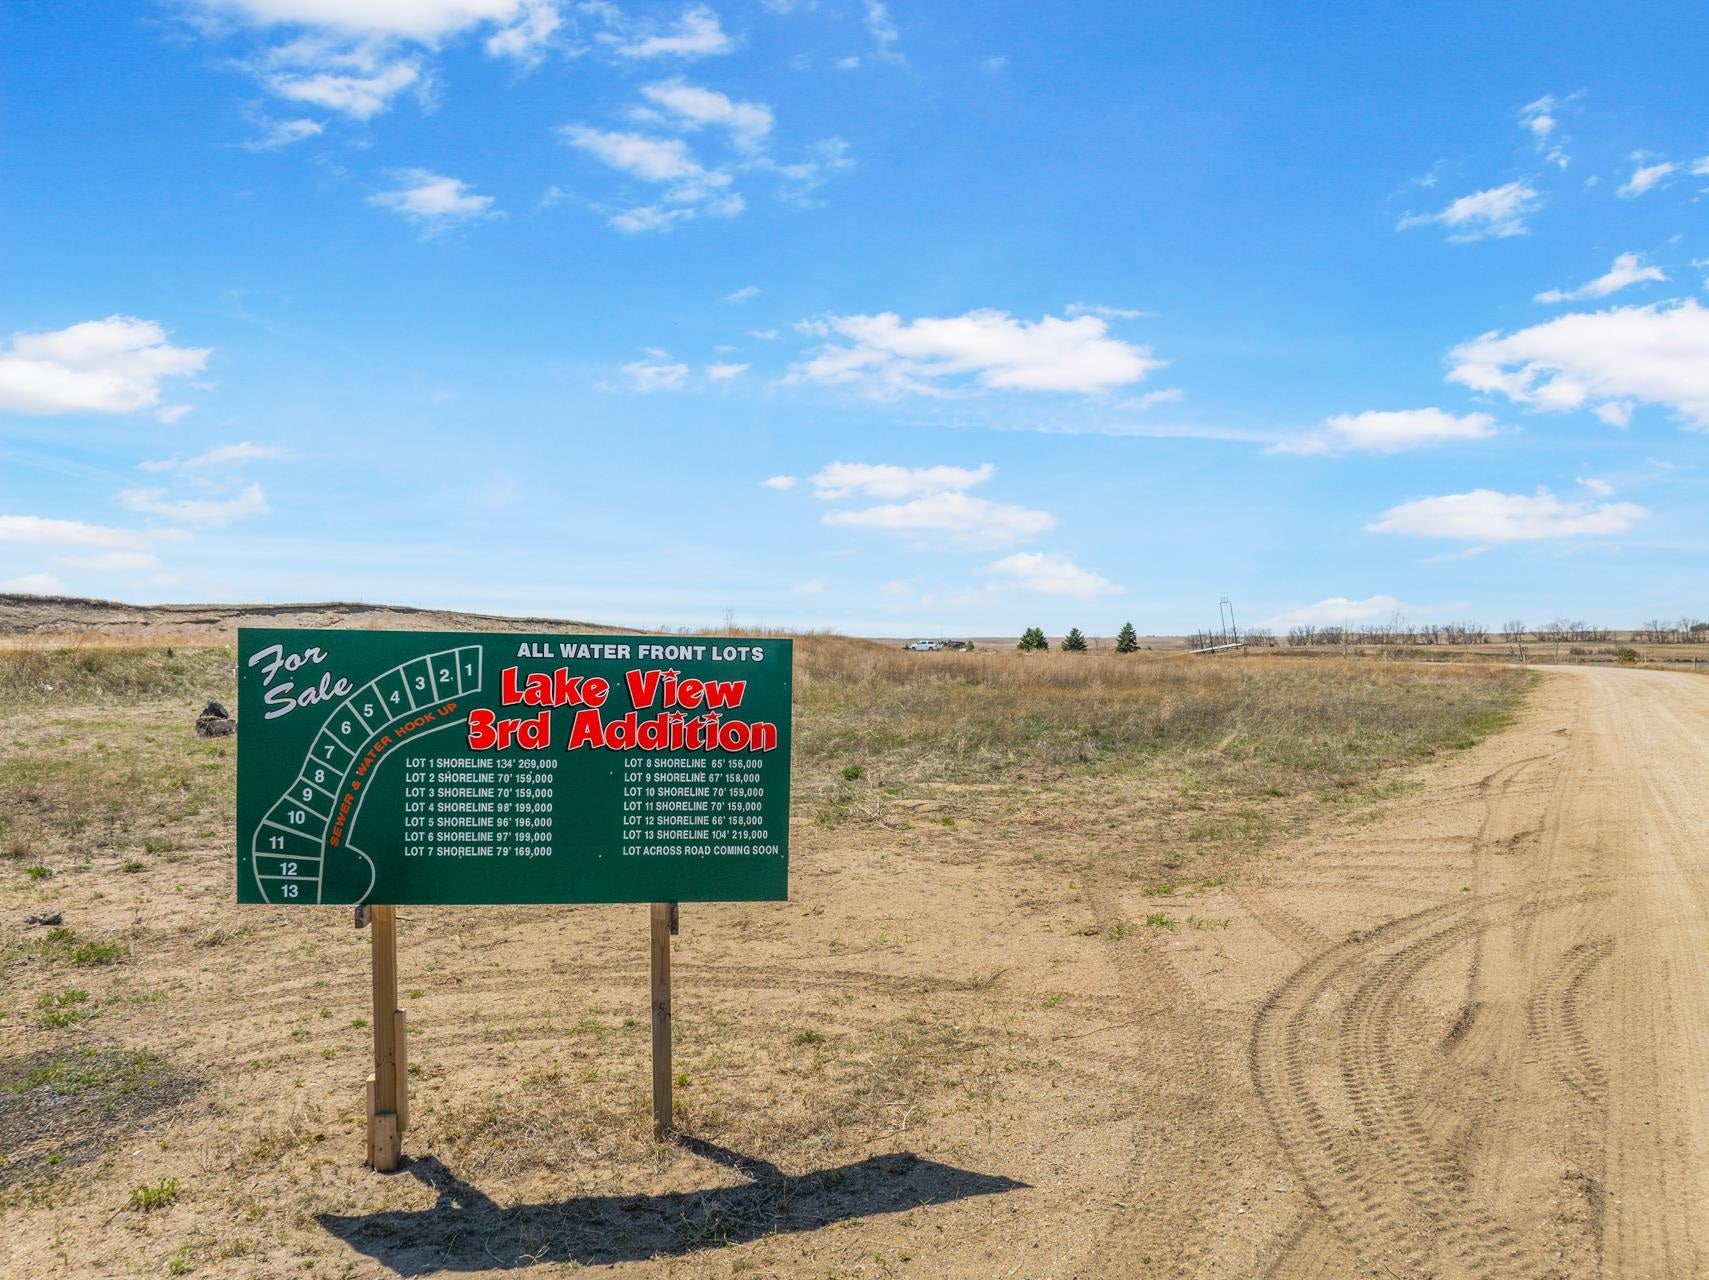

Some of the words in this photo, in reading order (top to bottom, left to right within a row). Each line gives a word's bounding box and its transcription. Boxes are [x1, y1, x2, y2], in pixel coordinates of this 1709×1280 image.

[516, 643, 555, 658] ALL
[559, 643, 631, 660] WATER
[638, 644, 706, 660] FRONT
[711, 645, 764, 662] LOTS
[248, 644, 328, 686] For
[465, 664, 472, 676] 1
[439, 669, 450, 682] 2
[415, 677, 426, 690] 3
[501, 665, 610, 708] Lake
[625, 667, 747, 710] View
[263, 672, 353, 720] Sale
[390, 691, 400, 704] 4
[364, 704, 374, 717] 5
[437, 702, 457, 716] UP
[341, 721, 351, 734] 6
[394, 712, 437, 737] HOOK
[467, 708, 552, 750] 3rd
[567, 708, 778, 752] Addition
[324, 746, 335, 759] 7
[356, 735, 393, 776] WATER
[406, 759, 427, 768] LOT
[429, 759, 434, 768] 1
[436, 759, 494, 768] SHORELINE
[496, 759, 516, 768] 134'
[518, 759, 558, 769] 269,000
[624, 759, 643, 768] LOT
[646, 759, 652, 768] 8
[654, 759, 707, 768] SHORELINE
[711, 760, 726, 769] 65'
[728, 760, 763, 769] 156,000
[314, 769, 325, 783] 8
[405, 773, 426, 782] LOT
[429, 774, 435, 783] 2
[437, 773, 495, 782] SHORELINE
[497, 774, 513, 783] 70'
[515, 773, 553, 784] 159,000
[624, 773, 643, 782] LOT
[645, 773, 652, 782] 9
[653, 773, 706, 782] SHORELINE
[708, 774, 723, 783] 67'
[725, 774, 760, 783] 158,000
[351, 781, 362, 790] &
[624, 787, 643, 796] LOT
[645, 788, 655, 797] 10
[657, 787, 710, 796] SHORELINE
[712, 788, 727, 797] 70'
[729, 788, 764, 797] 159,000
[302, 788, 313, 801] 9
[405, 788, 426, 797] LOT
[428, 788, 435, 797] 3
[437, 788, 495, 797] SHORELINE
[497, 789, 513, 798] 70'
[515, 789, 553, 798] 159,000
[405, 803, 426, 812] LOT
[428, 803, 435, 812] 4
[437, 803, 494, 812] SHORELINE
[497, 803, 512, 812] 98'
[514, 803, 553, 813] 199,000
[623, 802, 643, 811] LOT
[645, 802, 654, 811] 11
[655, 802, 708, 811] SHORELINE
[710, 802, 725, 811] 70'
[727, 802, 762, 812] 159,000
[287, 811, 306, 824] 10
[330, 793, 354, 848] SEWER
[405, 817, 425, 826] LOT
[428, 818, 434, 827] 5
[437, 817, 494, 826] SHORELINE
[496, 818, 512, 827] 96'
[514, 818, 553, 828] 196,000
[623, 816, 642, 825] LOT
[644, 816, 655, 825] 12
[656, 816, 710, 825] SHORELINE
[711, 816, 726, 825] 66'
[728, 816, 763, 826] 158,000
[404, 832, 425, 841] LOT
[427, 833, 434, 842] 6
[436, 832, 494, 841] SHORELINE
[496, 832, 512, 841] 97'
[514, 833, 552, 842] 199,000
[623, 830, 642, 839] LOT
[644, 831, 654, 840] 13
[656, 830, 709, 839] SHORELINE
[711, 831, 730, 840] 104'
[732, 830, 768, 840] 219,000
[269, 836, 285, 849] 11
[404, 847, 425, 856] LOT
[427, 847, 434, 856] 7
[436, 847, 494, 856] SHORELINE
[496, 847, 512, 856] 79'
[514, 847, 552, 858] 169,000
[623, 846, 642, 855] LOT
[643, 846, 682, 855] ACROSS
[684, 846, 711, 856] ROAD
[713, 846, 750, 855] COMING
[752, 846, 779, 855] SOON
[280, 862, 298, 876] 12
[281, 884, 299, 898] 13
